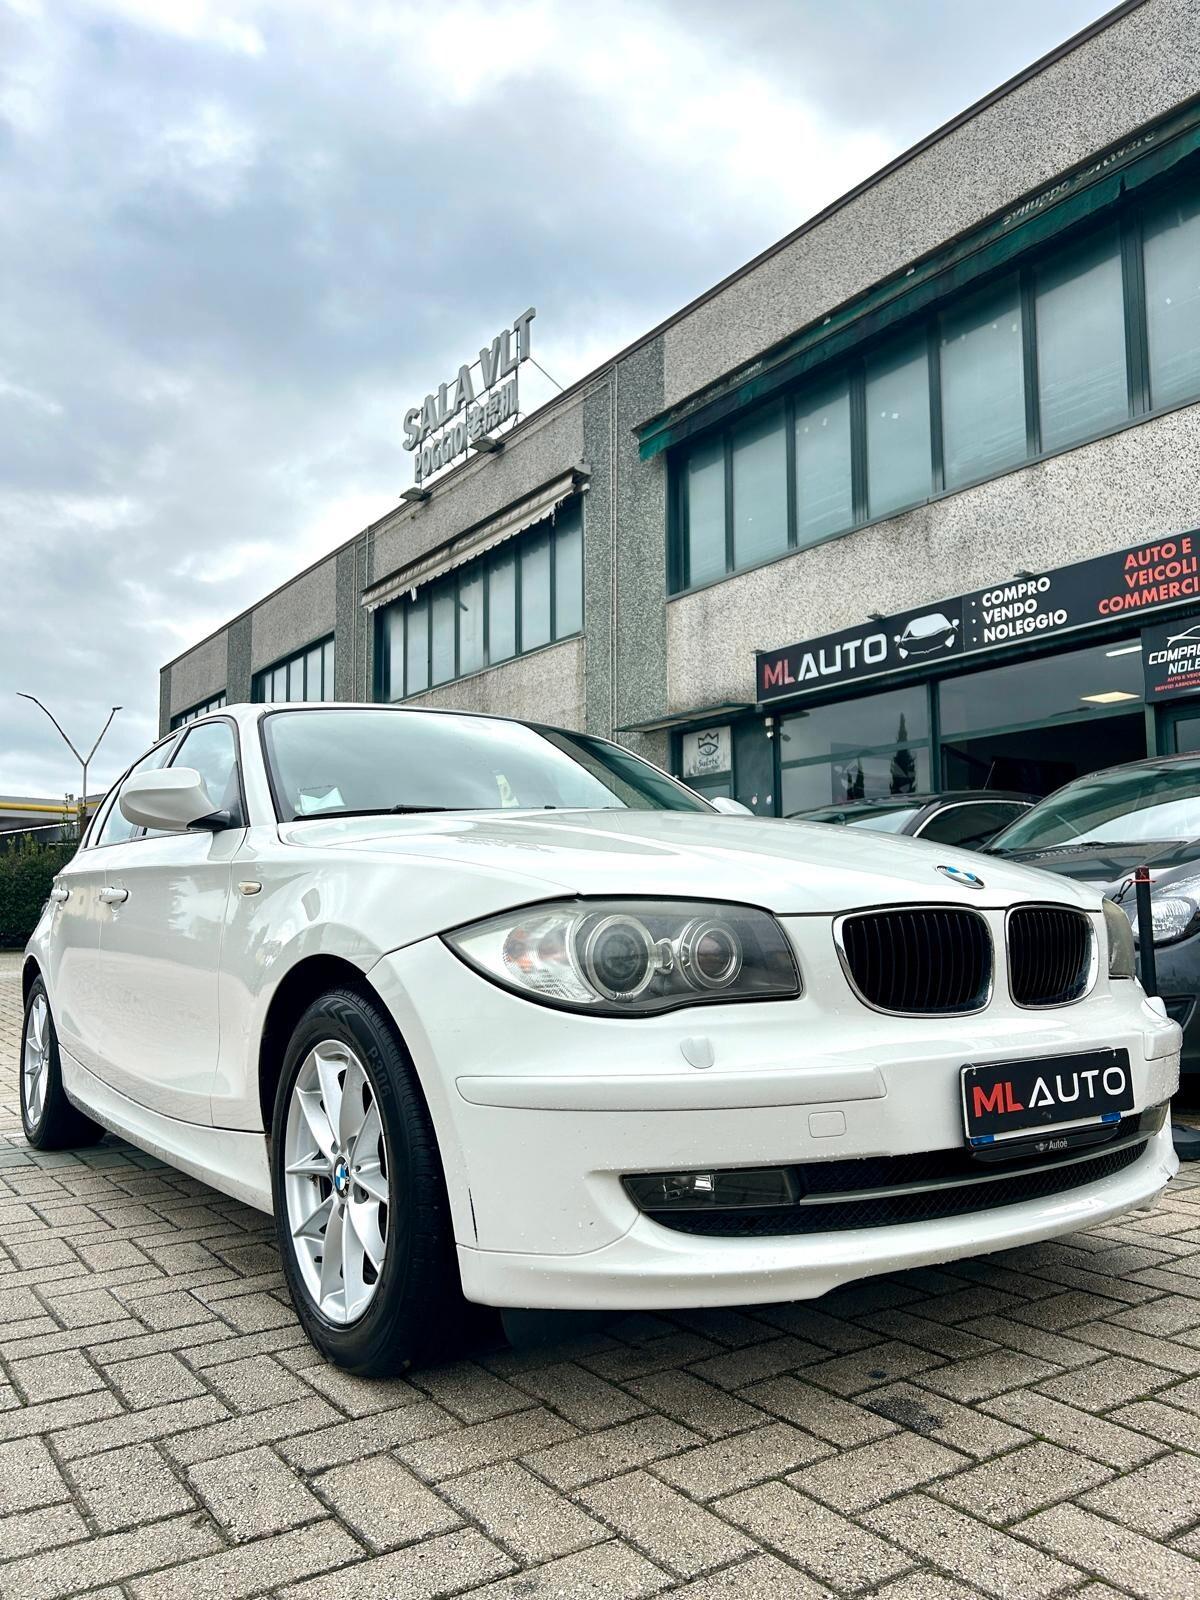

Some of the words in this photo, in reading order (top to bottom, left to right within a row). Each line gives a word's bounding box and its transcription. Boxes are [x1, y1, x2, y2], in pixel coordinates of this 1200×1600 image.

[402, 365, 475, 451] SALA
[479, 307, 536, 390] VLT
[414, 422, 467, 483] POGGIO
[1124, 543, 1176, 570] AUTO
[1181, 537, 1192, 554] E
[1124, 556, 1197, 588] VEICOLI
[982, 576, 1050, 607] COMPRO
[1098, 577, 1199, 614] COMMERCI
[982, 599, 1038, 625] VENDO
[983, 609, 1068, 643] NOLEGGIO
